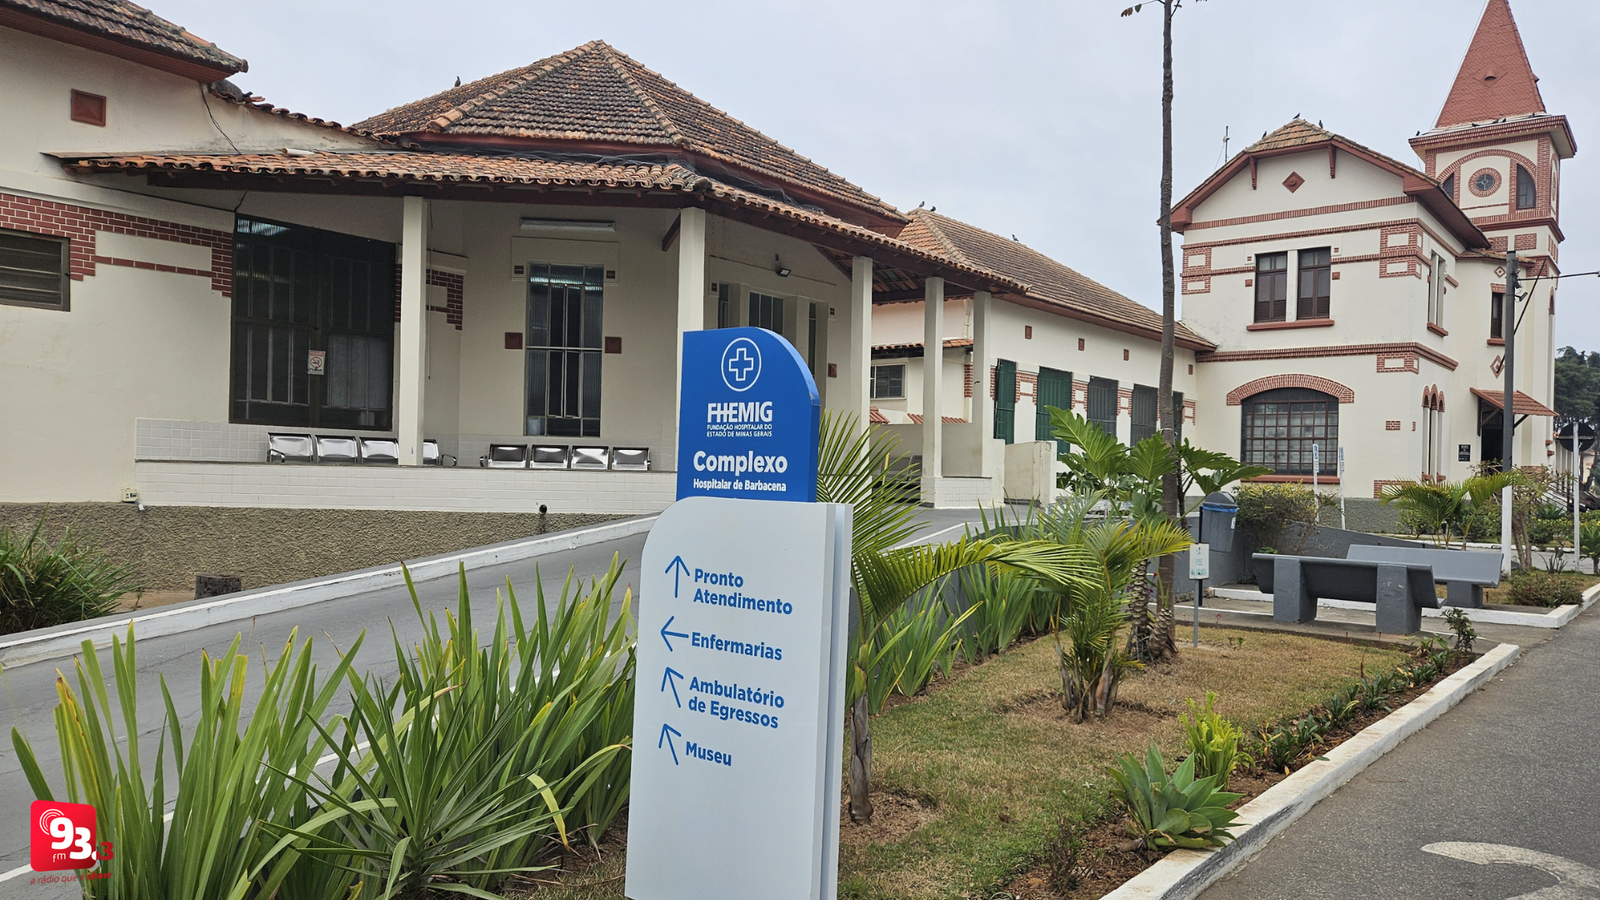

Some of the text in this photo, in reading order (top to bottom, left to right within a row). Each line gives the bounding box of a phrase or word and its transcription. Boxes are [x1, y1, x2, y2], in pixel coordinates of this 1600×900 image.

[707, 401, 773, 422] FHEMIG
[707, 423, 733, 431] FUNDAÇÃO
[693, 450, 788, 476] Complexo
[693, 478, 787, 491] Hospitalar de Barbacena
[694, 568, 744, 588] Pronto
[693, 588, 793, 615] Atendimento
[691, 631, 782, 661] Enfermarias
[689, 676, 785, 708] Ambulatório
[688, 696, 779, 729] de Egressos
[685, 741, 732, 767] Museu
